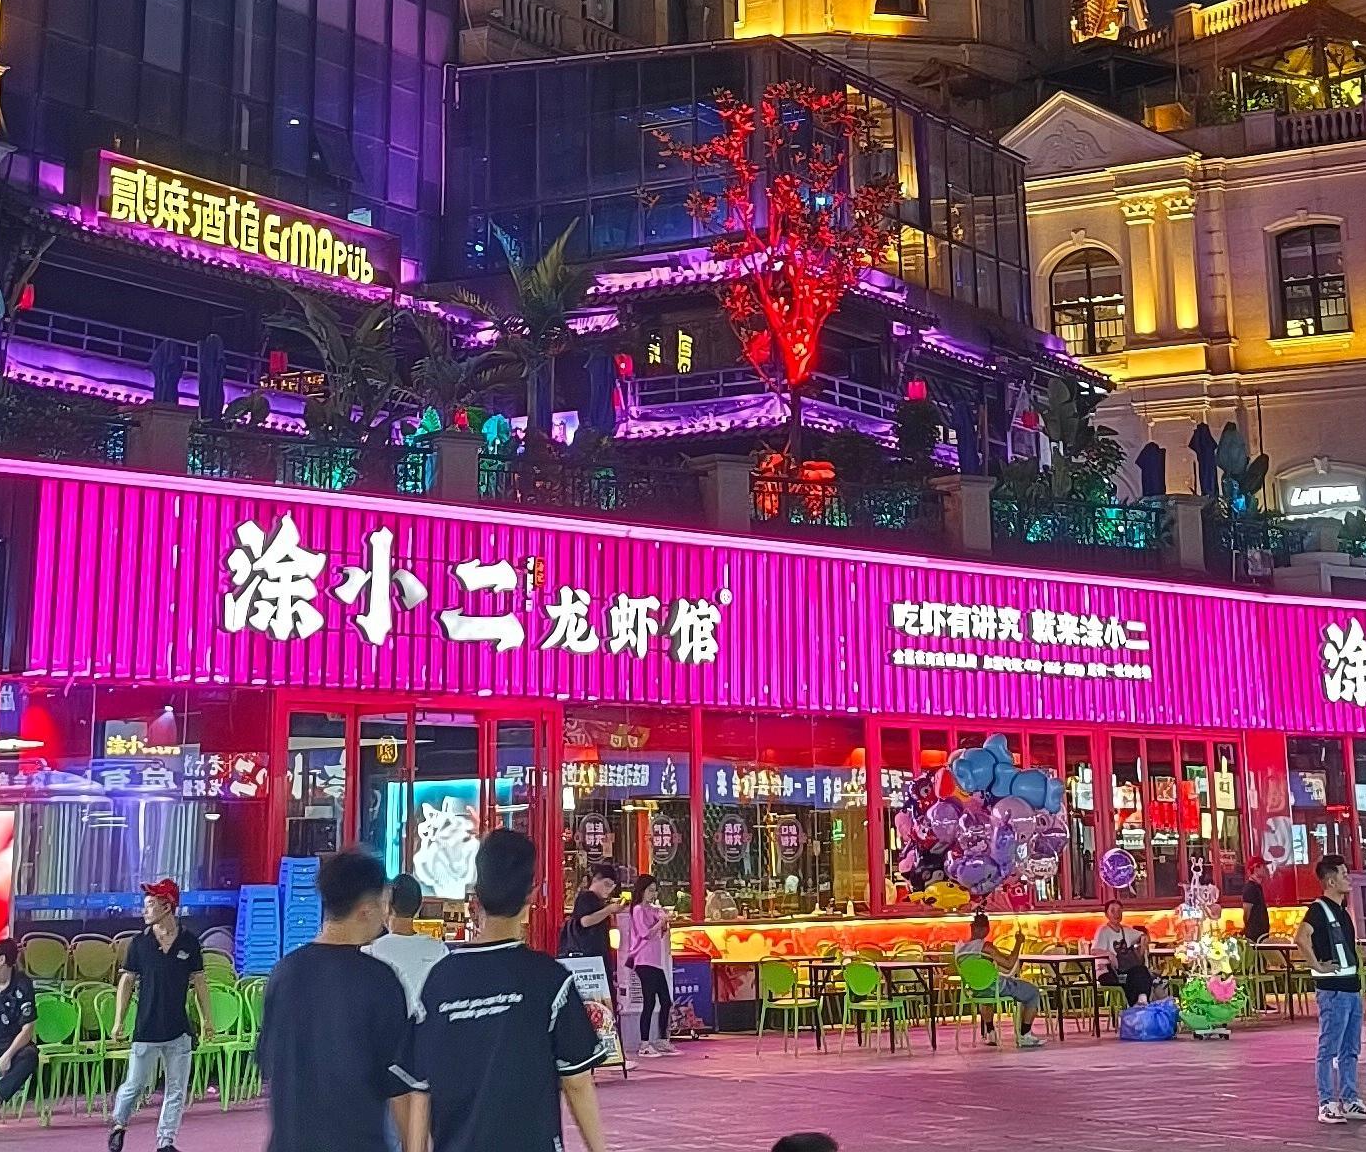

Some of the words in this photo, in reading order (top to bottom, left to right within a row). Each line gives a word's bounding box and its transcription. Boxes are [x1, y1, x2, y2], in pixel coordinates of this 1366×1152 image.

[224, 510, 525, 652] 涂小二
[540, 585, 722, 665] 龙虾馆
[892, 600, 1023, 642] 吃虾有讲究
